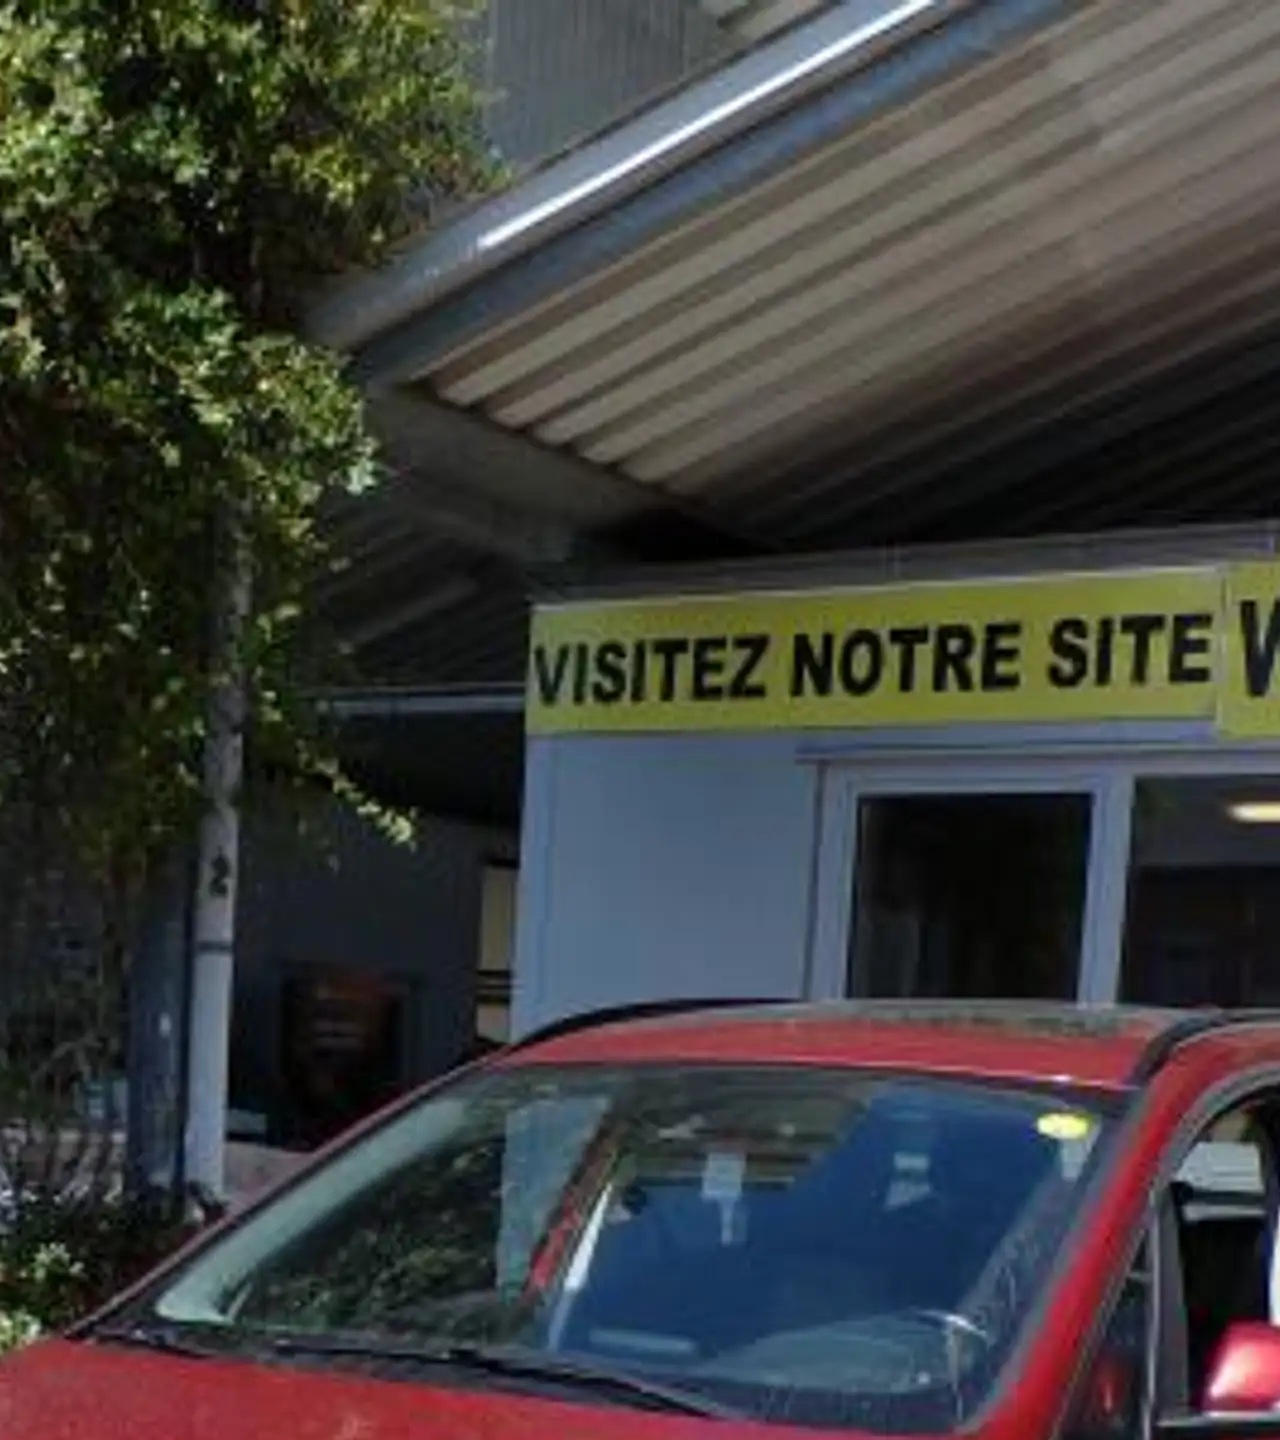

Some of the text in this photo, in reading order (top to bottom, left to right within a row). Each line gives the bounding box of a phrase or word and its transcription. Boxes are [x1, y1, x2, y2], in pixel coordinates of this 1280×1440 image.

[534, 635, 769, 704] VISITEZ
[790, 624, 1022, 698] NOTRE
[1047, 613, 1214, 689] SITE
